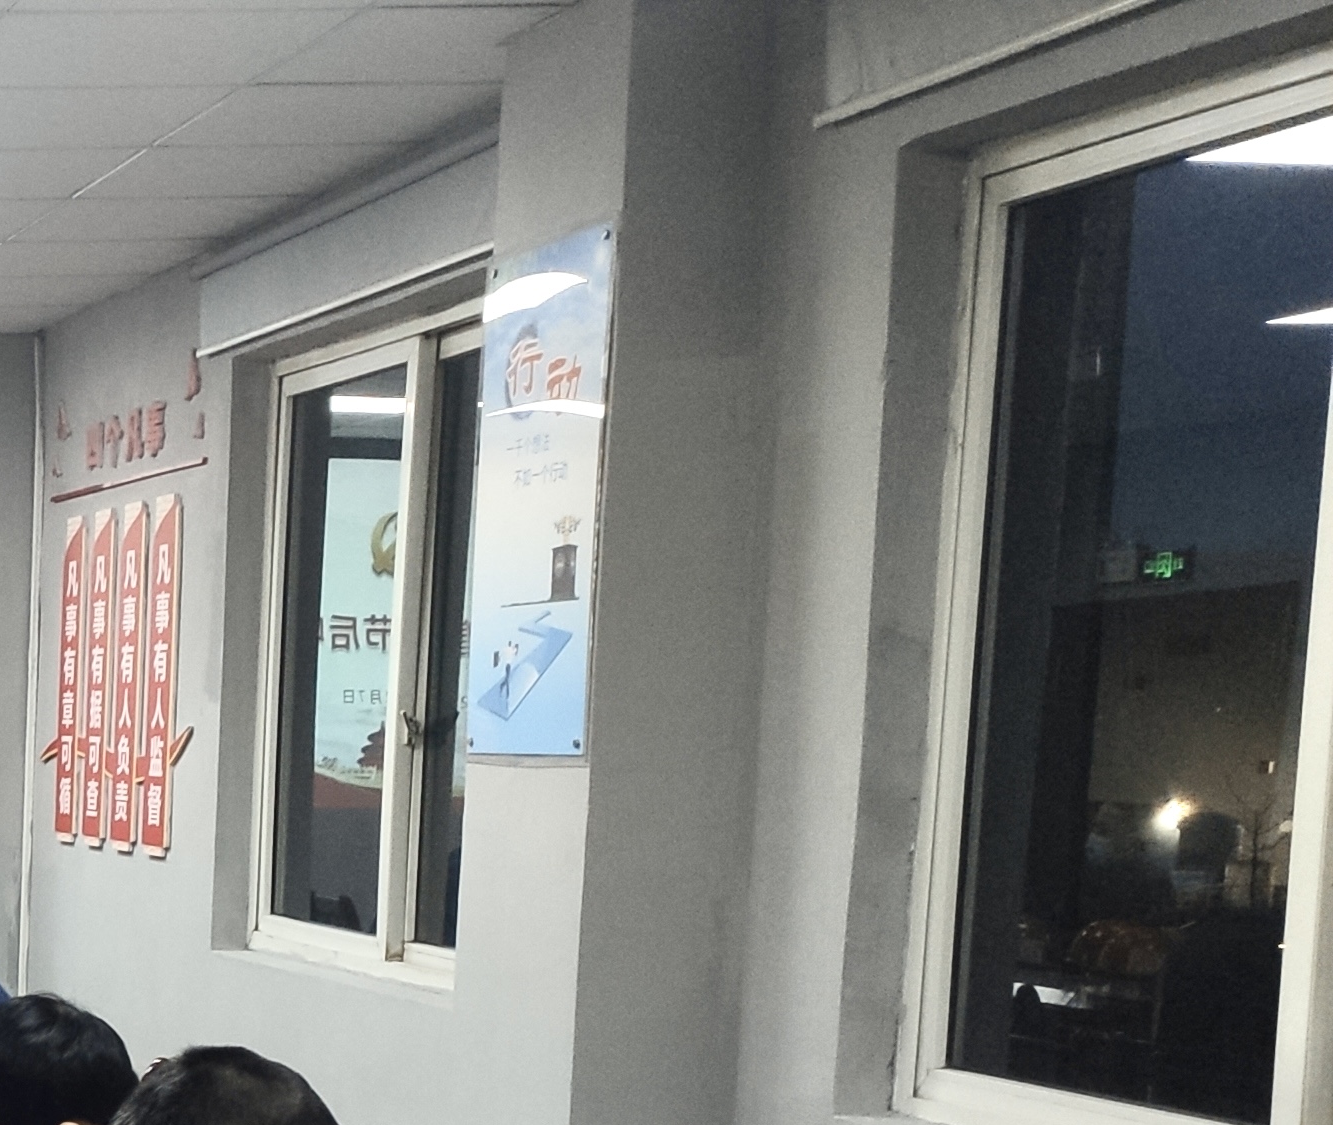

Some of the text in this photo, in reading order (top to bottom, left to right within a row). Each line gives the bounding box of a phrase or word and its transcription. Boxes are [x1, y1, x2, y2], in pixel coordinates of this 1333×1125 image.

[506, 338, 583, 416] 行动
[59, 560, 78, 816] 凡事有章可循
[85, 555, 106, 817] 凡事有据可查
[114, 549, 138, 822] 凡事有人负责
[147, 543, 172, 827] 凡事有人监督
